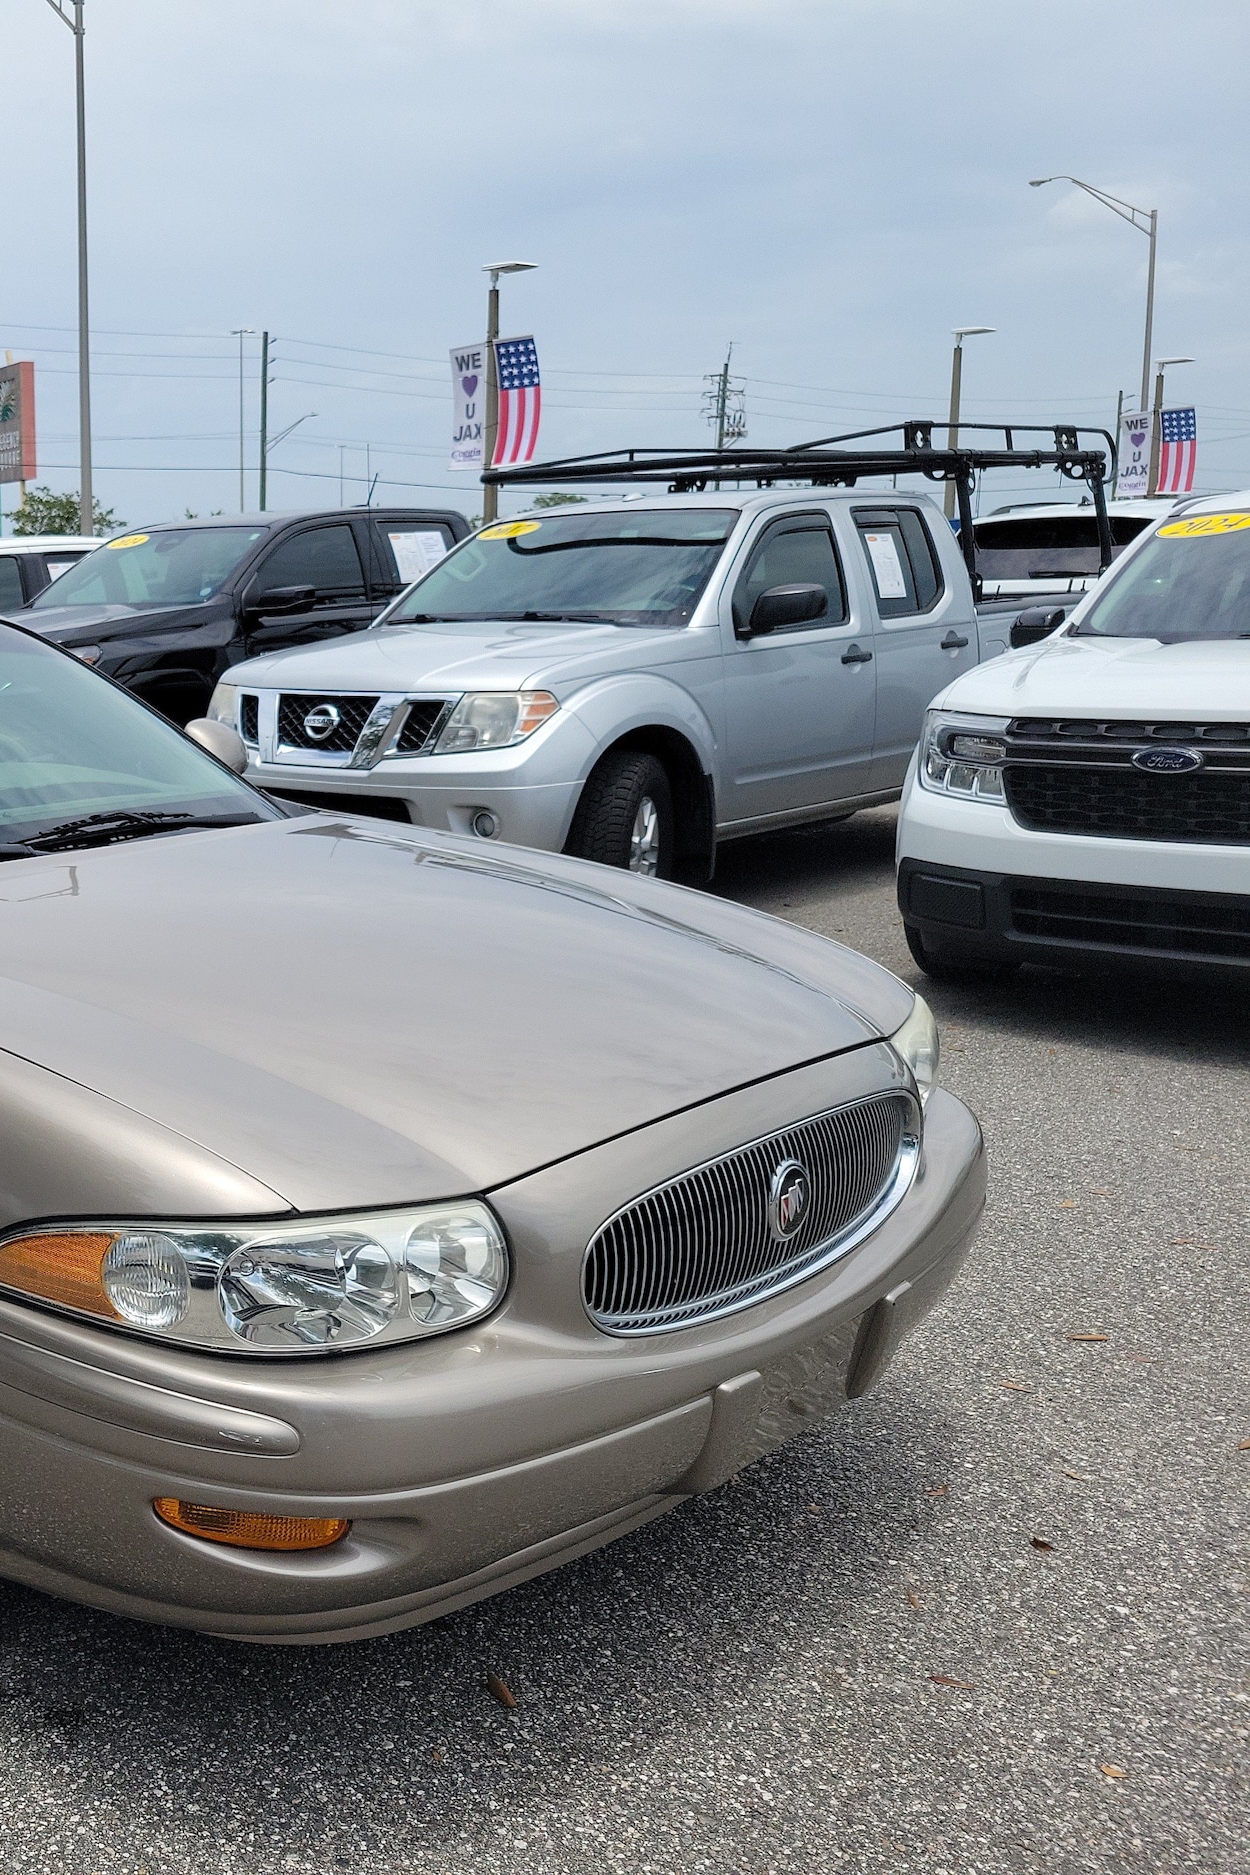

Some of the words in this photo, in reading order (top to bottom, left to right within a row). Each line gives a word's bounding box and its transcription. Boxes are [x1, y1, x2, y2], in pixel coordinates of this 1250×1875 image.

[455, 353, 482, 372] WE
[465, 403, 475, 420] U
[1125, 417, 1149, 431] WE
[453, 422, 482, 442] JAX
[1132, 451, 1142, 462] U
[1121, 464, 1148, 477] JAX
[1147, 754, 1184, 768] Ford
